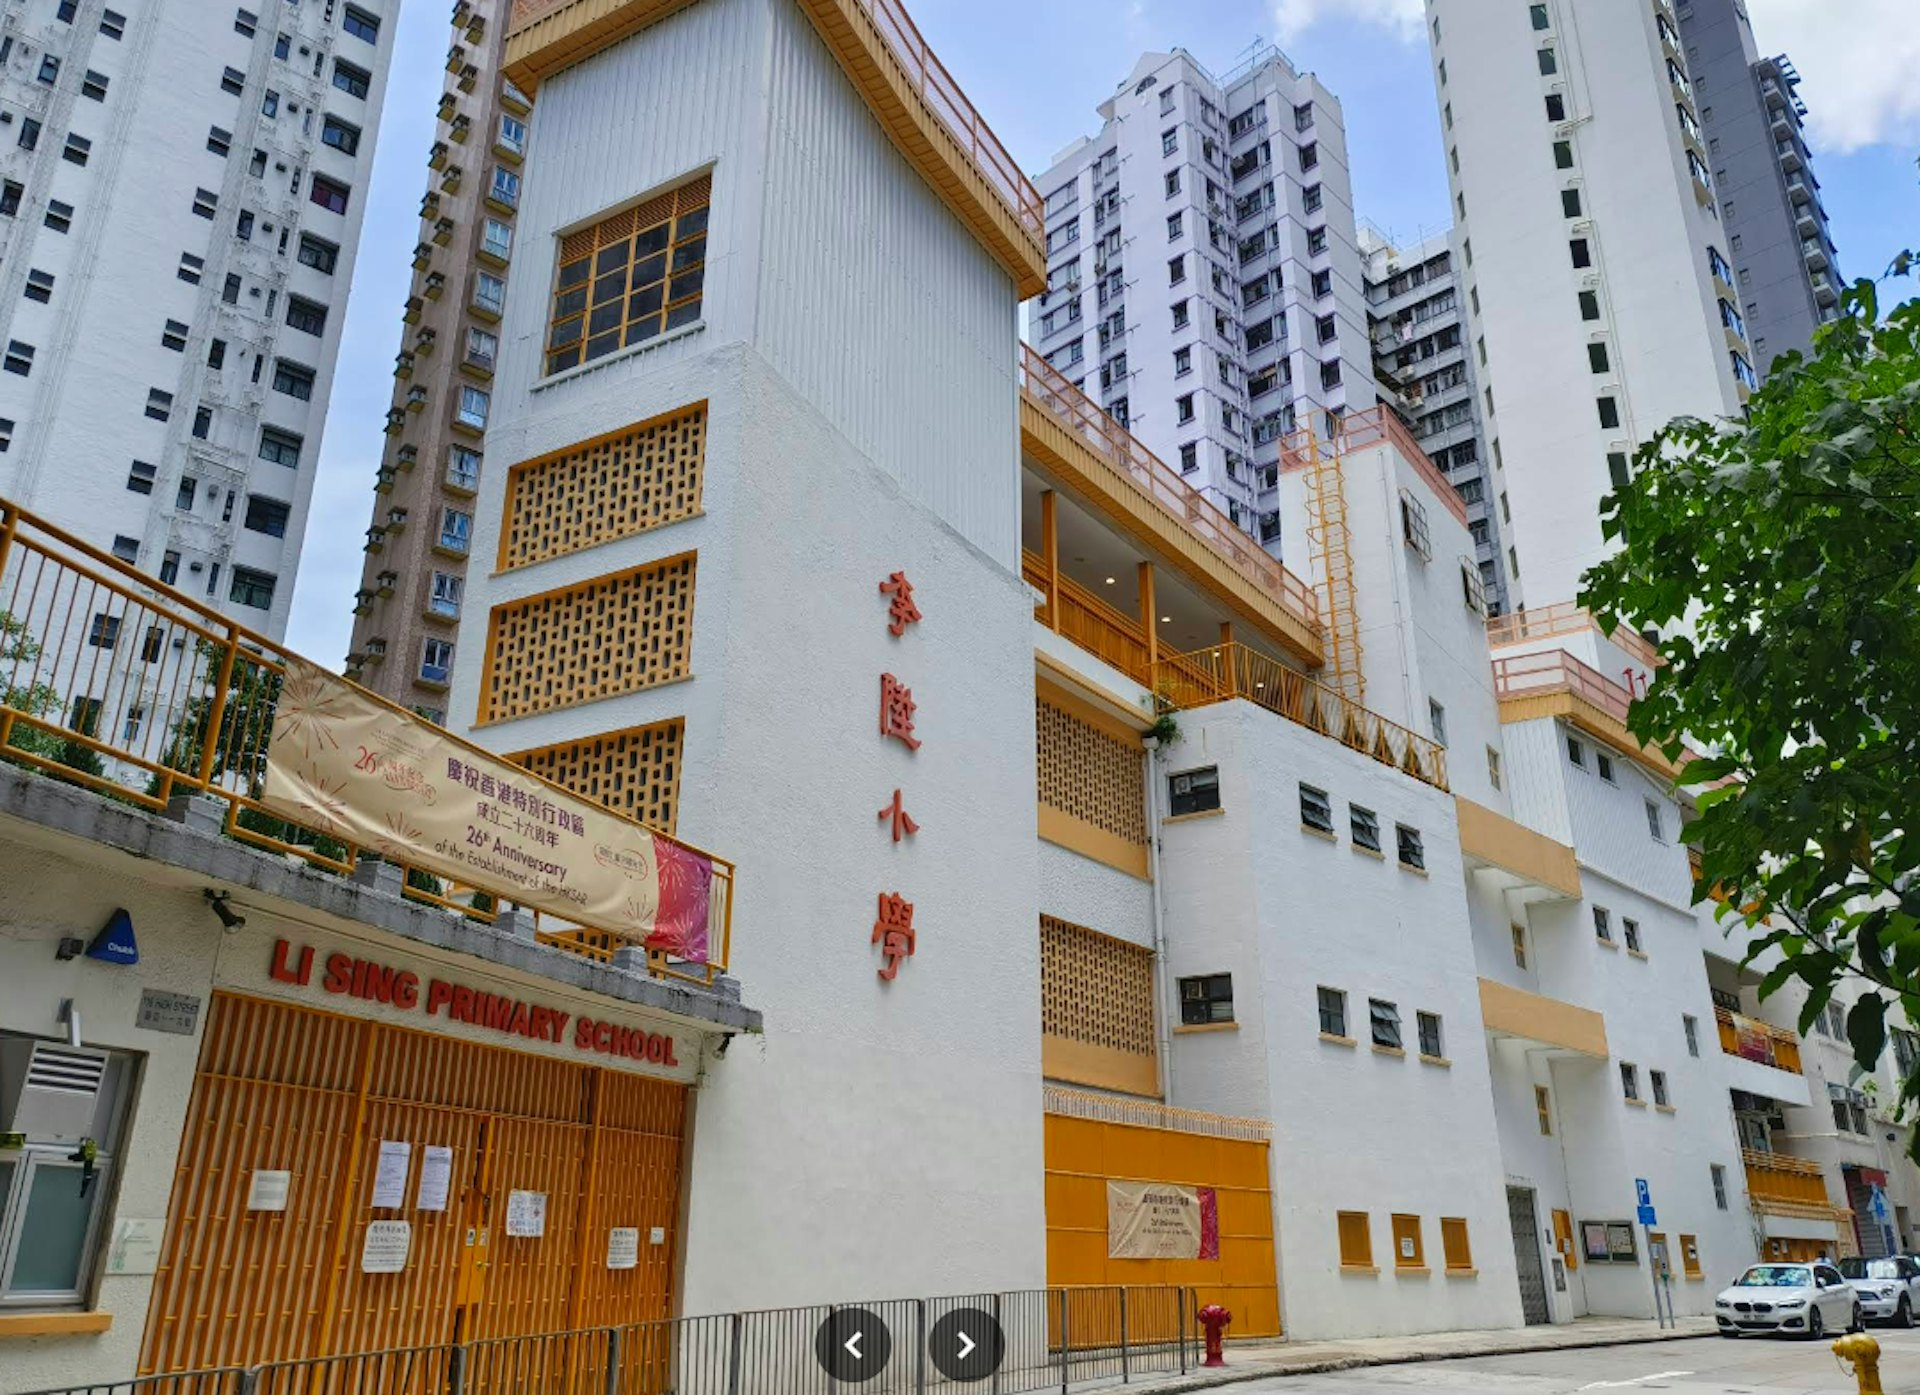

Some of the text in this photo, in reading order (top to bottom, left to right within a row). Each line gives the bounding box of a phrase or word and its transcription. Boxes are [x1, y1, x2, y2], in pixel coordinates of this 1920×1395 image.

[447, 757, 585, 837] 慶祝香港特別行政區
[872, 571, 922, 980] 李陞小學
[434, 839, 447, 853] of
[450, 845, 465, 861] the
[467, 851, 528, 885] Establishment
[529, 875, 540, 889] of
[542, 878, 557, 894] the
[492, 836, 567, 882] Anniversary
[270, 939, 678, 1067] LI SING PRIMARY SCHOOL
